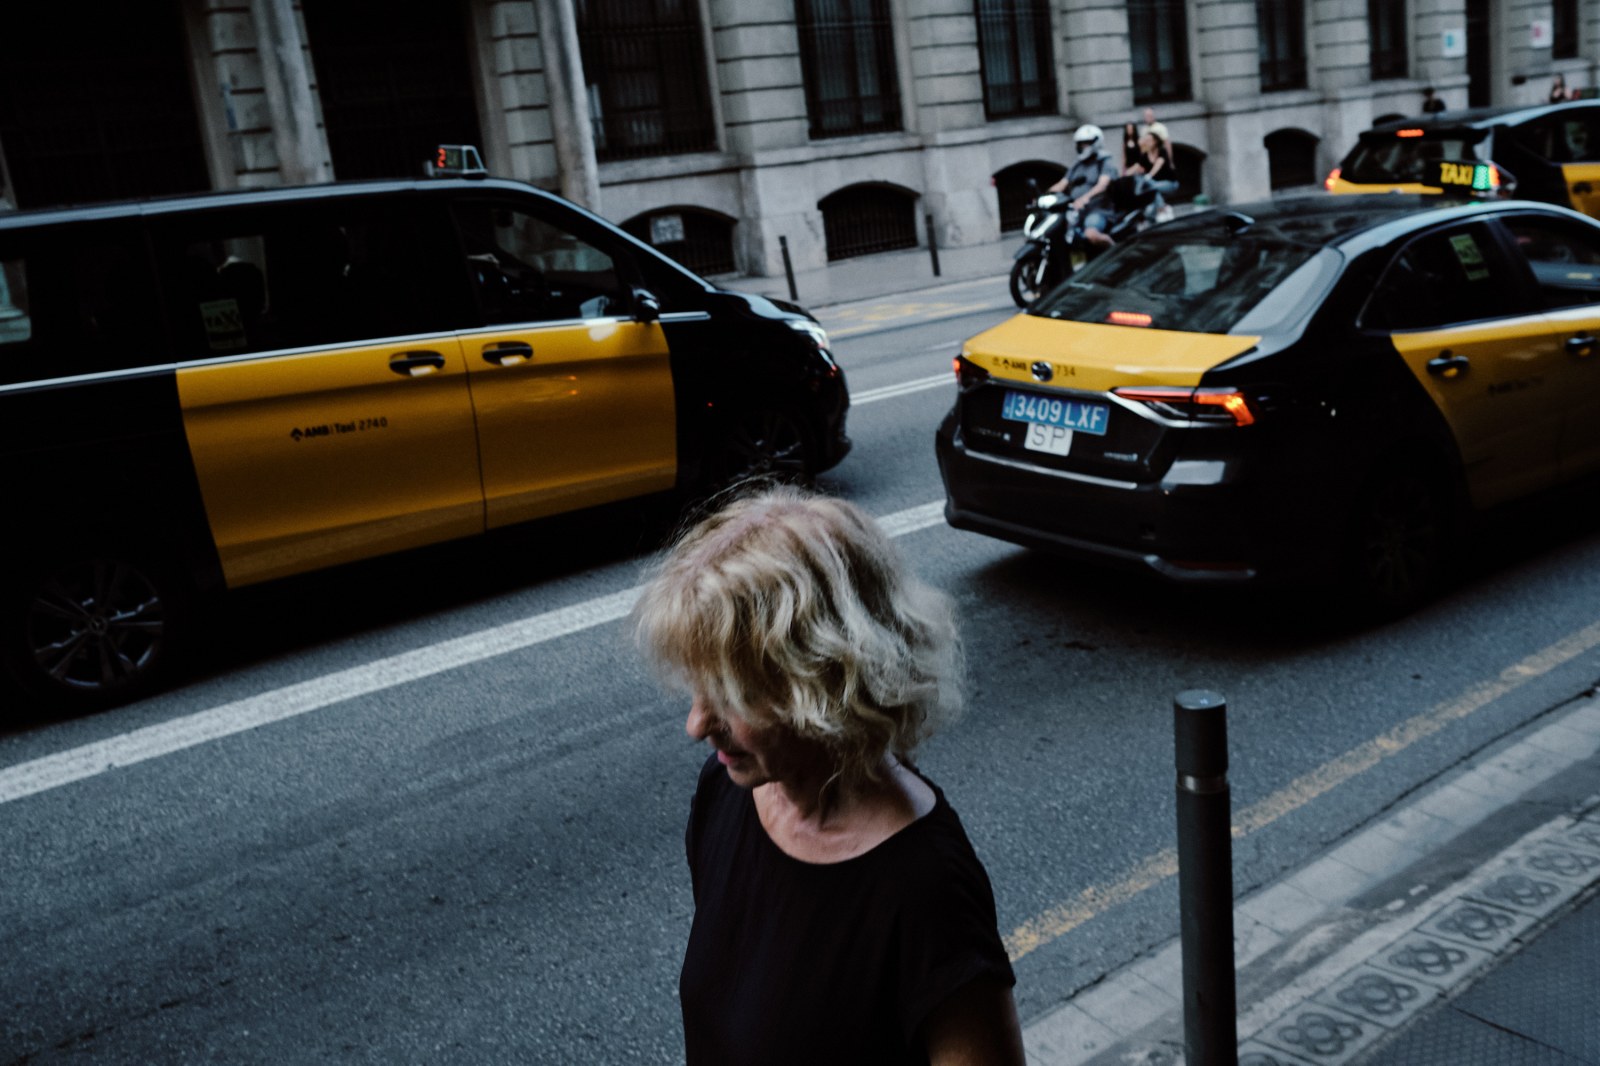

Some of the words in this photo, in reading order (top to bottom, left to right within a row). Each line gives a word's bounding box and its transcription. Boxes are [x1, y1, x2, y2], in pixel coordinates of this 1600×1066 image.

[1439, 162, 1474, 186] TAXI
[1015, 395, 1063, 424] 3409
[1064, 402, 1106, 430] LXF
[305, 425, 330, 438] AMB
[333, 422, 357, 434] Taxi
[359, 416, 389, 431] 2740
[1032, 423, 1066, 449] SP
